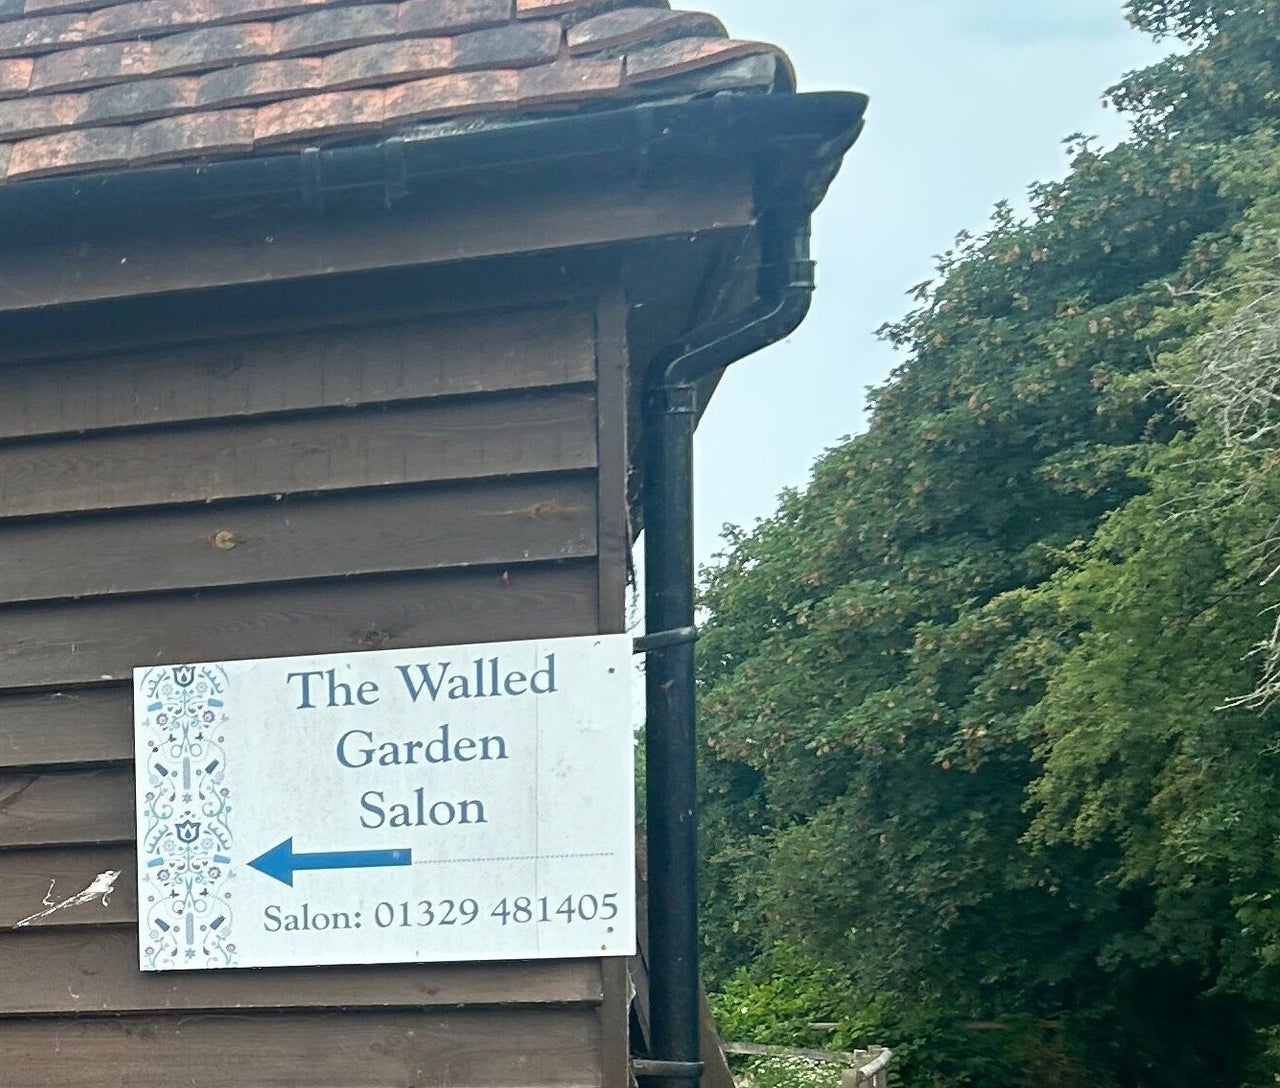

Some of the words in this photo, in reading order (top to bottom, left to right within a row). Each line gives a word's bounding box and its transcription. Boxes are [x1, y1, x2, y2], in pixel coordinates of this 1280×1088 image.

[286, 668, 381, 711] The
[395, 652, 559, 704] Walled
[335, 723, 510, 769] Garden
[359, 786, 488, 829] Salon
[262, 902, 363, 933] Salon:
[373, 897, 479, 928] 01329
[489, 892, 619, 928] 481405
